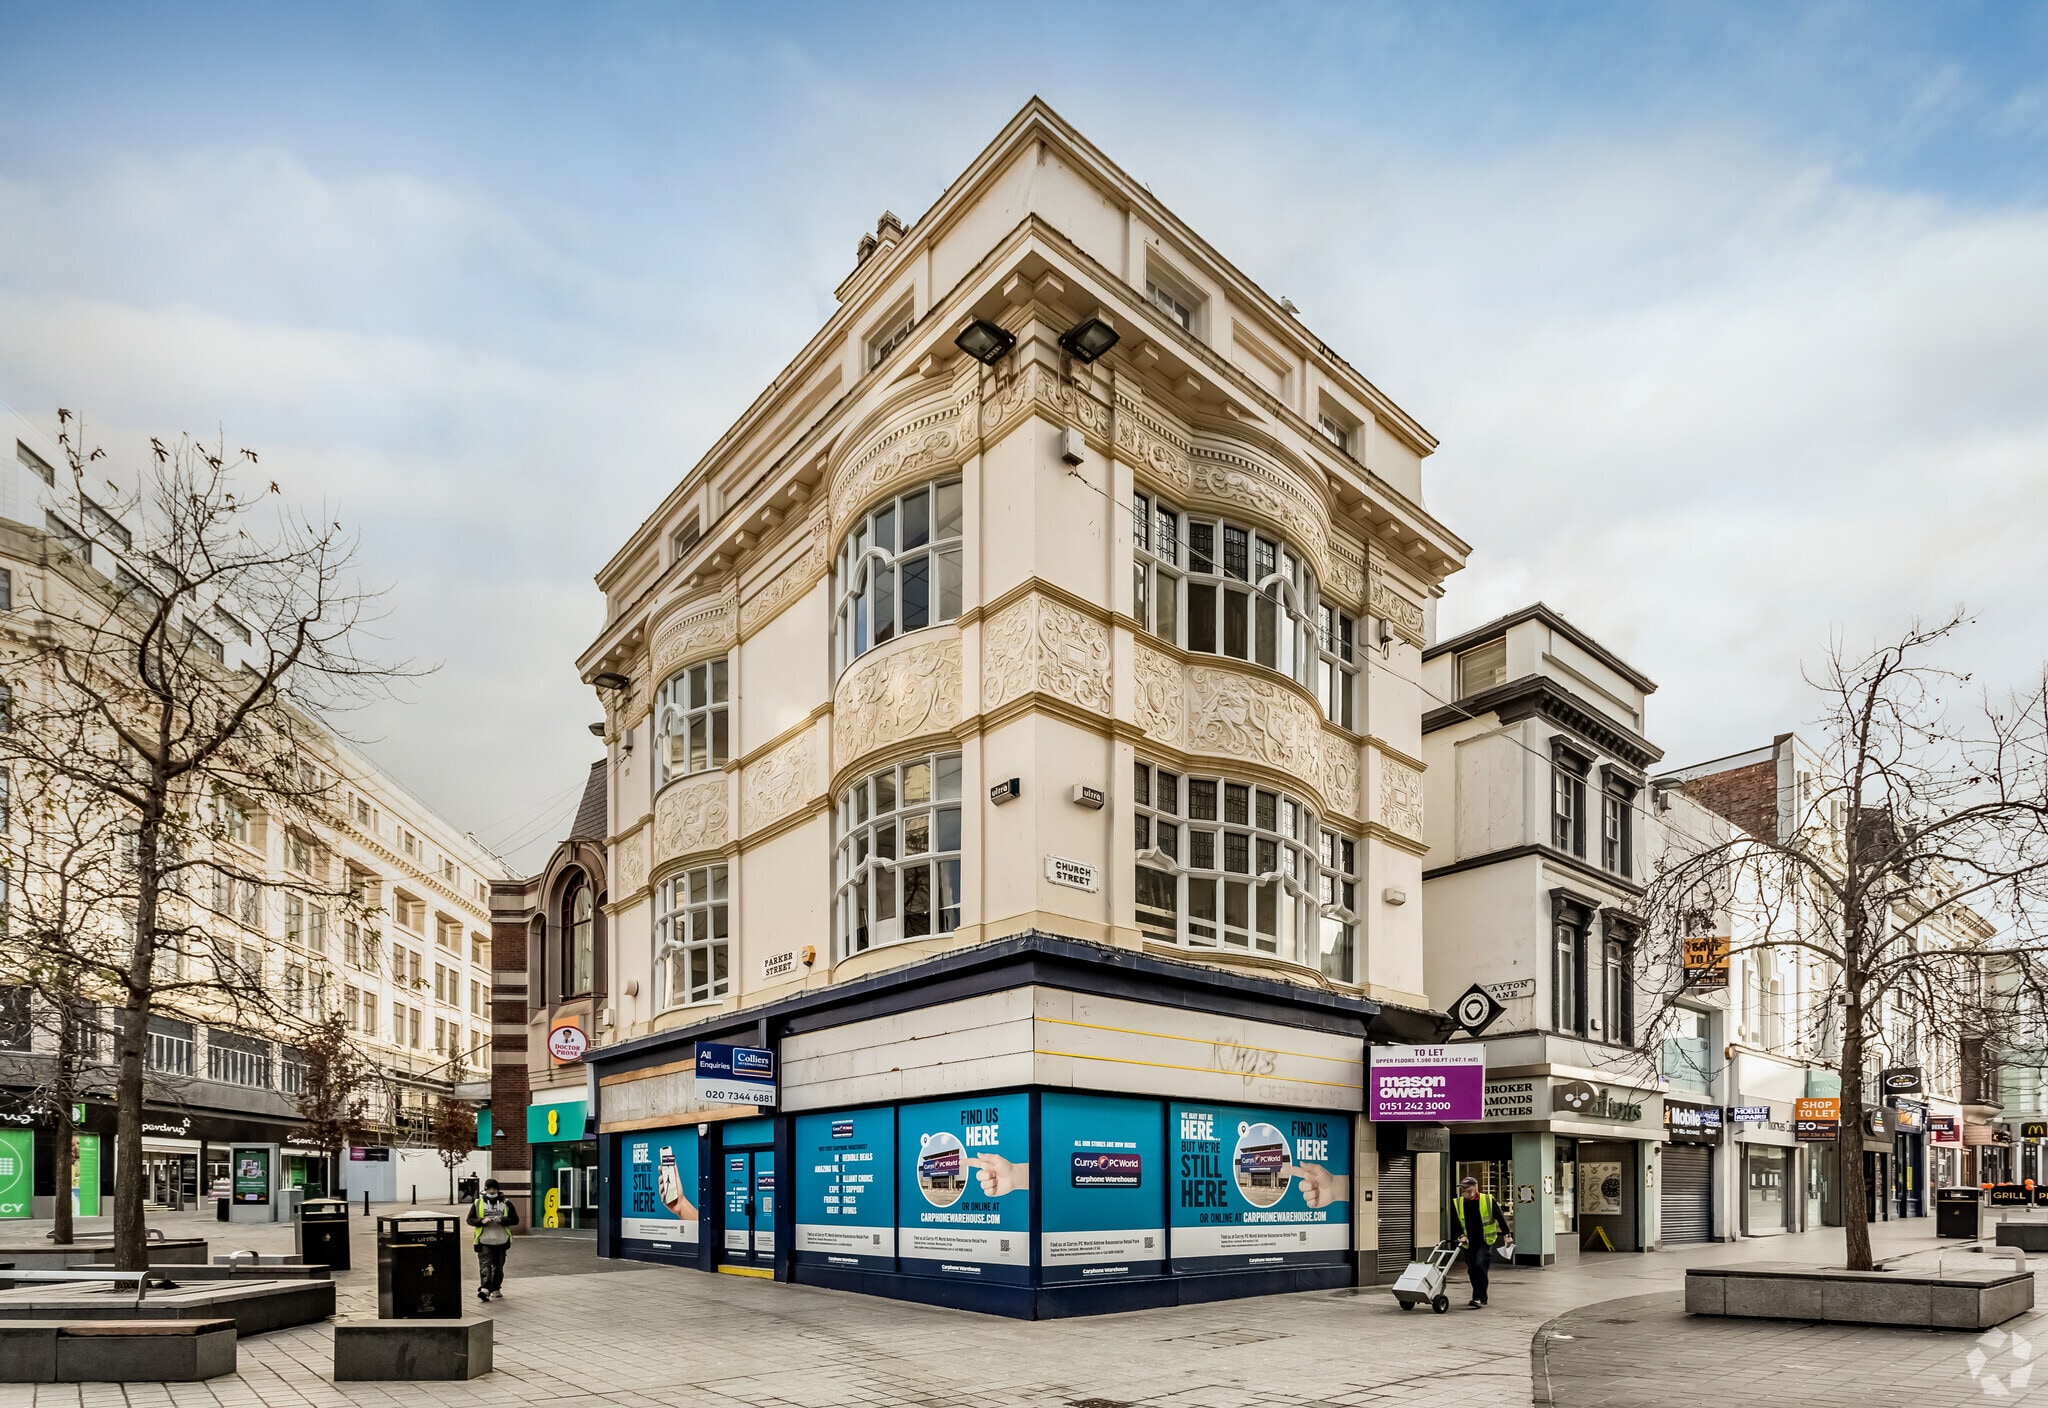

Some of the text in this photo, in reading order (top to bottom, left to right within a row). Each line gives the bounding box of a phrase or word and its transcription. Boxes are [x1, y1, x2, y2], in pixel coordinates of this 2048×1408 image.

[992, 784, 1008, 797] ultra
[1084, 789, 1100, 801] ultra
[1056, 862, 1091, 877] CHURCH
[1056, 872, 1090, 886] STREET
[764, 952, 793, 967] PARKER
[1690, 954, 1703, 964] TO
[766, 962, 792, 976] STREET
[1488, 981, 1528, 992] AYTON
[700, 1051, 769, 1064] All Colliers
[700, 1061, 730, 1070] Enquiries
[1380, 1076, 1446, 1087] mason
[706, 1090, 773, 1102] 020 7344 6881
[1404, 1102, 1423, 1110] 242
[1426, 1102, 1450, 1110] 3000
[961, 1108, 998, 1125] FIND US
[1672, 1107, 1700, 1126] Mobile
[1181, 1120, 1220, 1141] HERE...
[1292, 1120, 1328, 1138] FIND US
[1798, 1122, 1816, 1130] EO
[966, 1125, 999, 1146] HERE
[1182, 1141, 1220, 1153] BUT WE'RE
[1297, 1139, 1328, 1161] HERE
[1074, 1158, 1098, 1168] Currys
[1182, 1154, 1222, 1178] STILL
[633, 1174, 652, 1190] STILL
[1182, 1180, 1228, 1208] HERE
[633, 1192, 655, 1213] HERE
[962, 1202, 999, 1211] OR ONLINE AT
[921, 1213, 1000, 1224] CARPHONEWAREHOUSE.COM
[1200, 1211, 1326, 1223] OR ONLINE AT CARPHONEWAREHOUSE.COM
